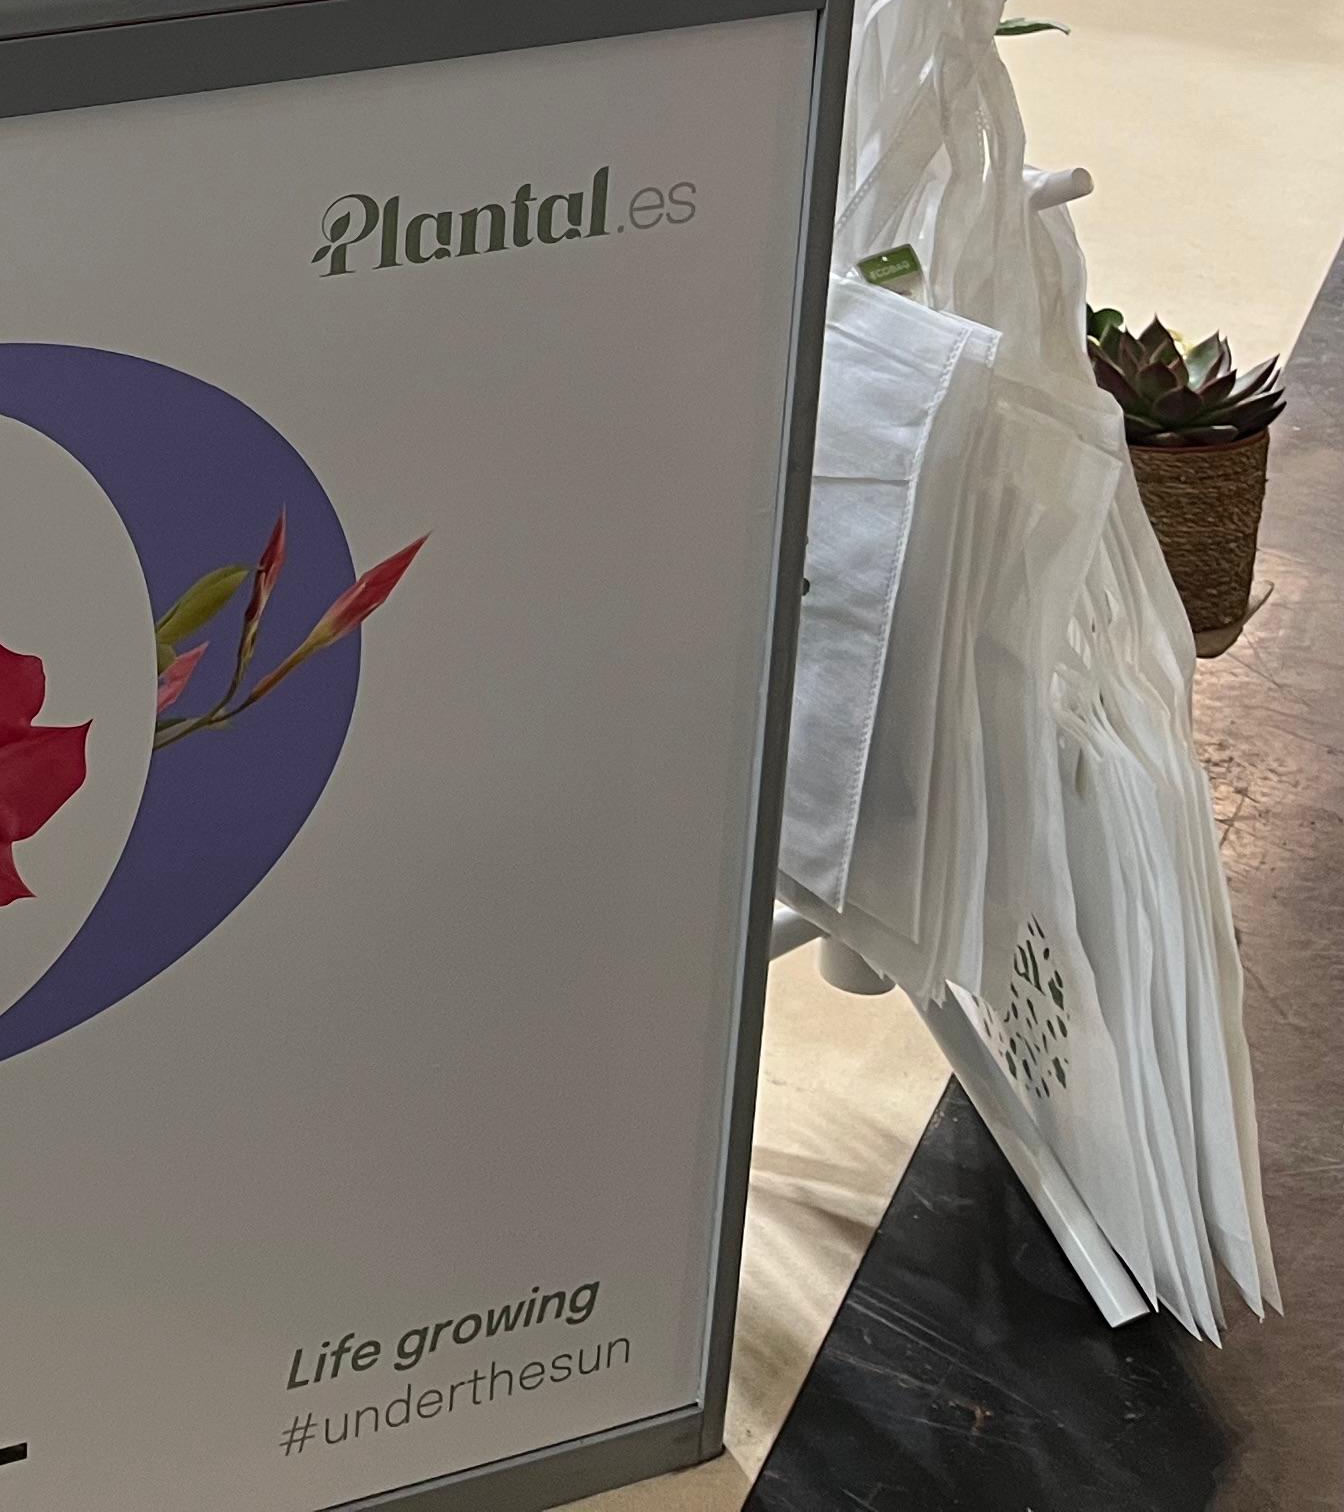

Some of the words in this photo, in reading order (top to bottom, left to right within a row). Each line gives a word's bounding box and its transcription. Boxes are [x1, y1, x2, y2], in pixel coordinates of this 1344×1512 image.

[311, 165, 697, 278] Plantal.es
[286, 1332, 381, 1390] Life
[393, 1281, 600, 1371] growing
[278, 1336, 631, 1457] #underthesun
